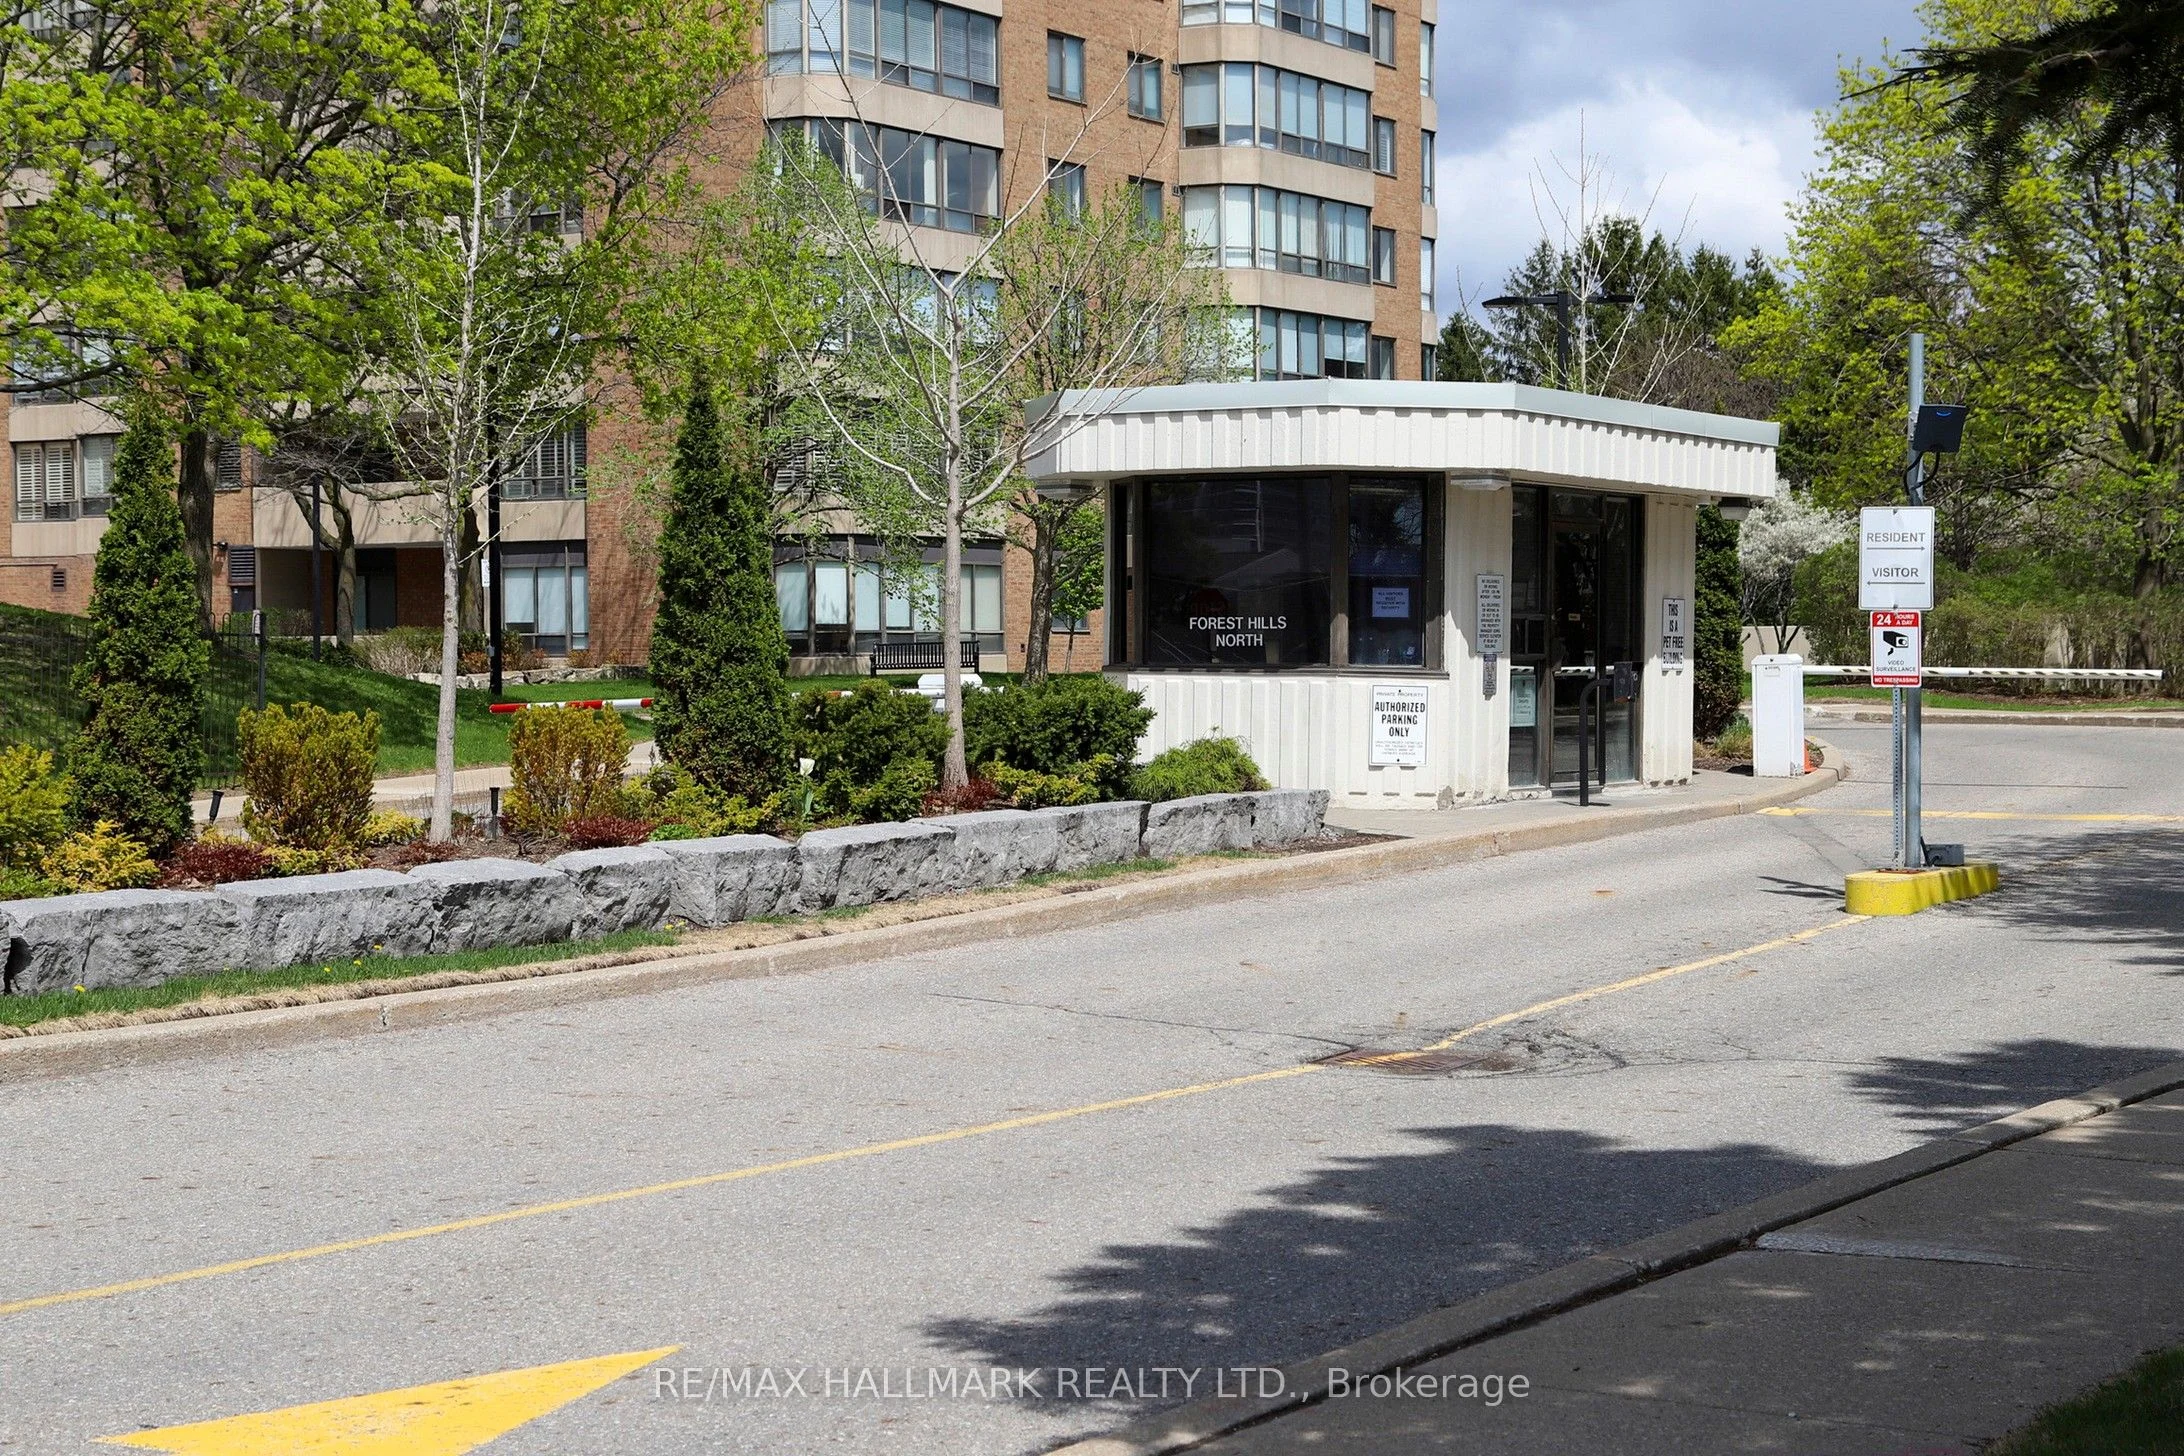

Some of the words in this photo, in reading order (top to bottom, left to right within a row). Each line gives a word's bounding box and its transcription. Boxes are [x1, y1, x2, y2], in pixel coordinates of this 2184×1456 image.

[1866, 532, 1926, 542] RESIDENT
[1872, 568, 1919, 577] VISITOR
[1668, 604, 1678, 616] THIS
[1190, 617, 1243, 630] FOREST
[1248, 616, 1287, 629] HILLS
[1876, 614, 1891, 625] 24
[1669, 620, 1674, 632] IS
[1674, 620, 1678, 632] A
[1216, 634, 1263, 647] NORTH
[1663, 636, 1672, 648] PET
[1672, 636, 1683, 648] FREE
[1663, 652, 1683, 664] BUILDING
[1375, 702, 1426, 712] AUTHORIZED
[1382, 714, 1418, 725] PARKING
[1389, 727, 1409, 737] ONLY
